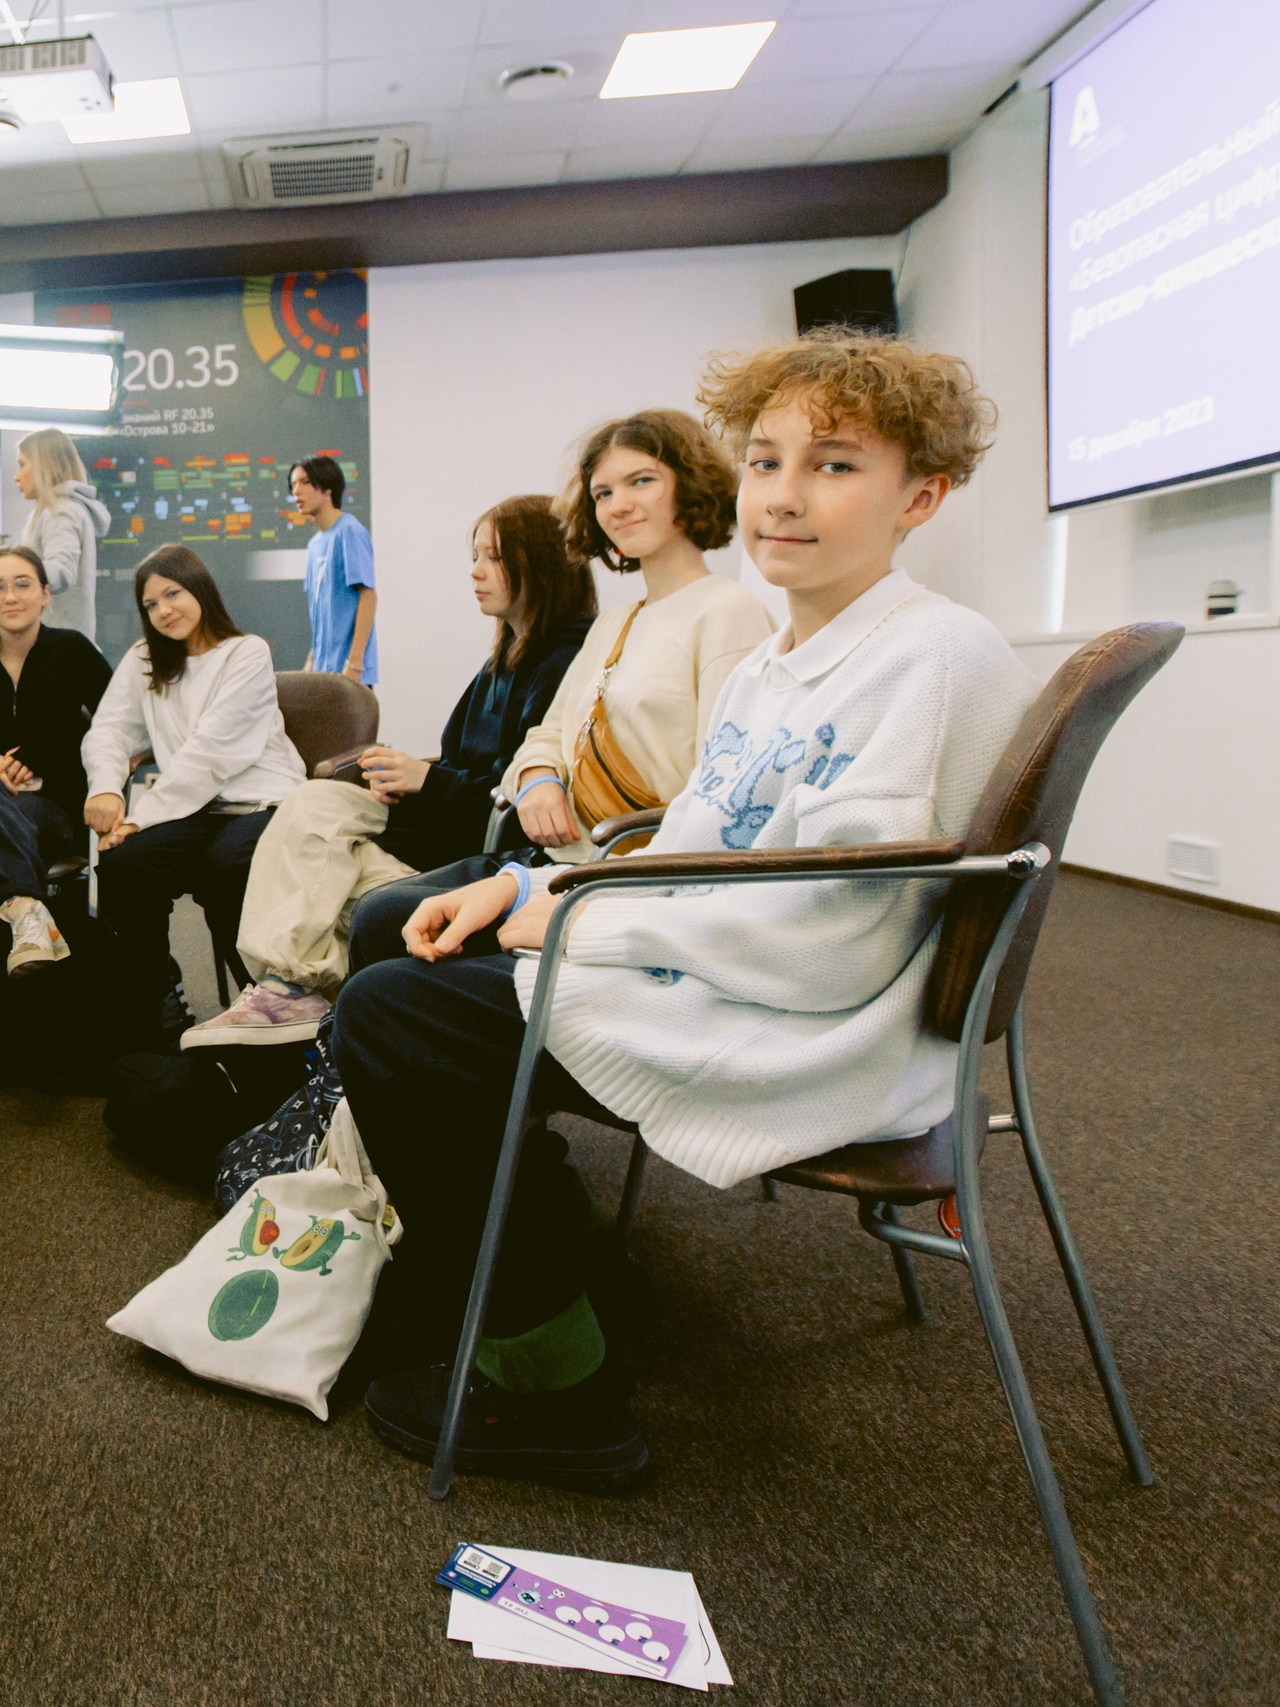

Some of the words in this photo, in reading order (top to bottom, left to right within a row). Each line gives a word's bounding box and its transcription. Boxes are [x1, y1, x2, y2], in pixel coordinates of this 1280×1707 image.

[122, 344, 239, 391] 20.35
[163, 408, 179, 420] RF
[181, 406, 215, 421] 20.35
[1162, 395, 1215, 436] 2023
